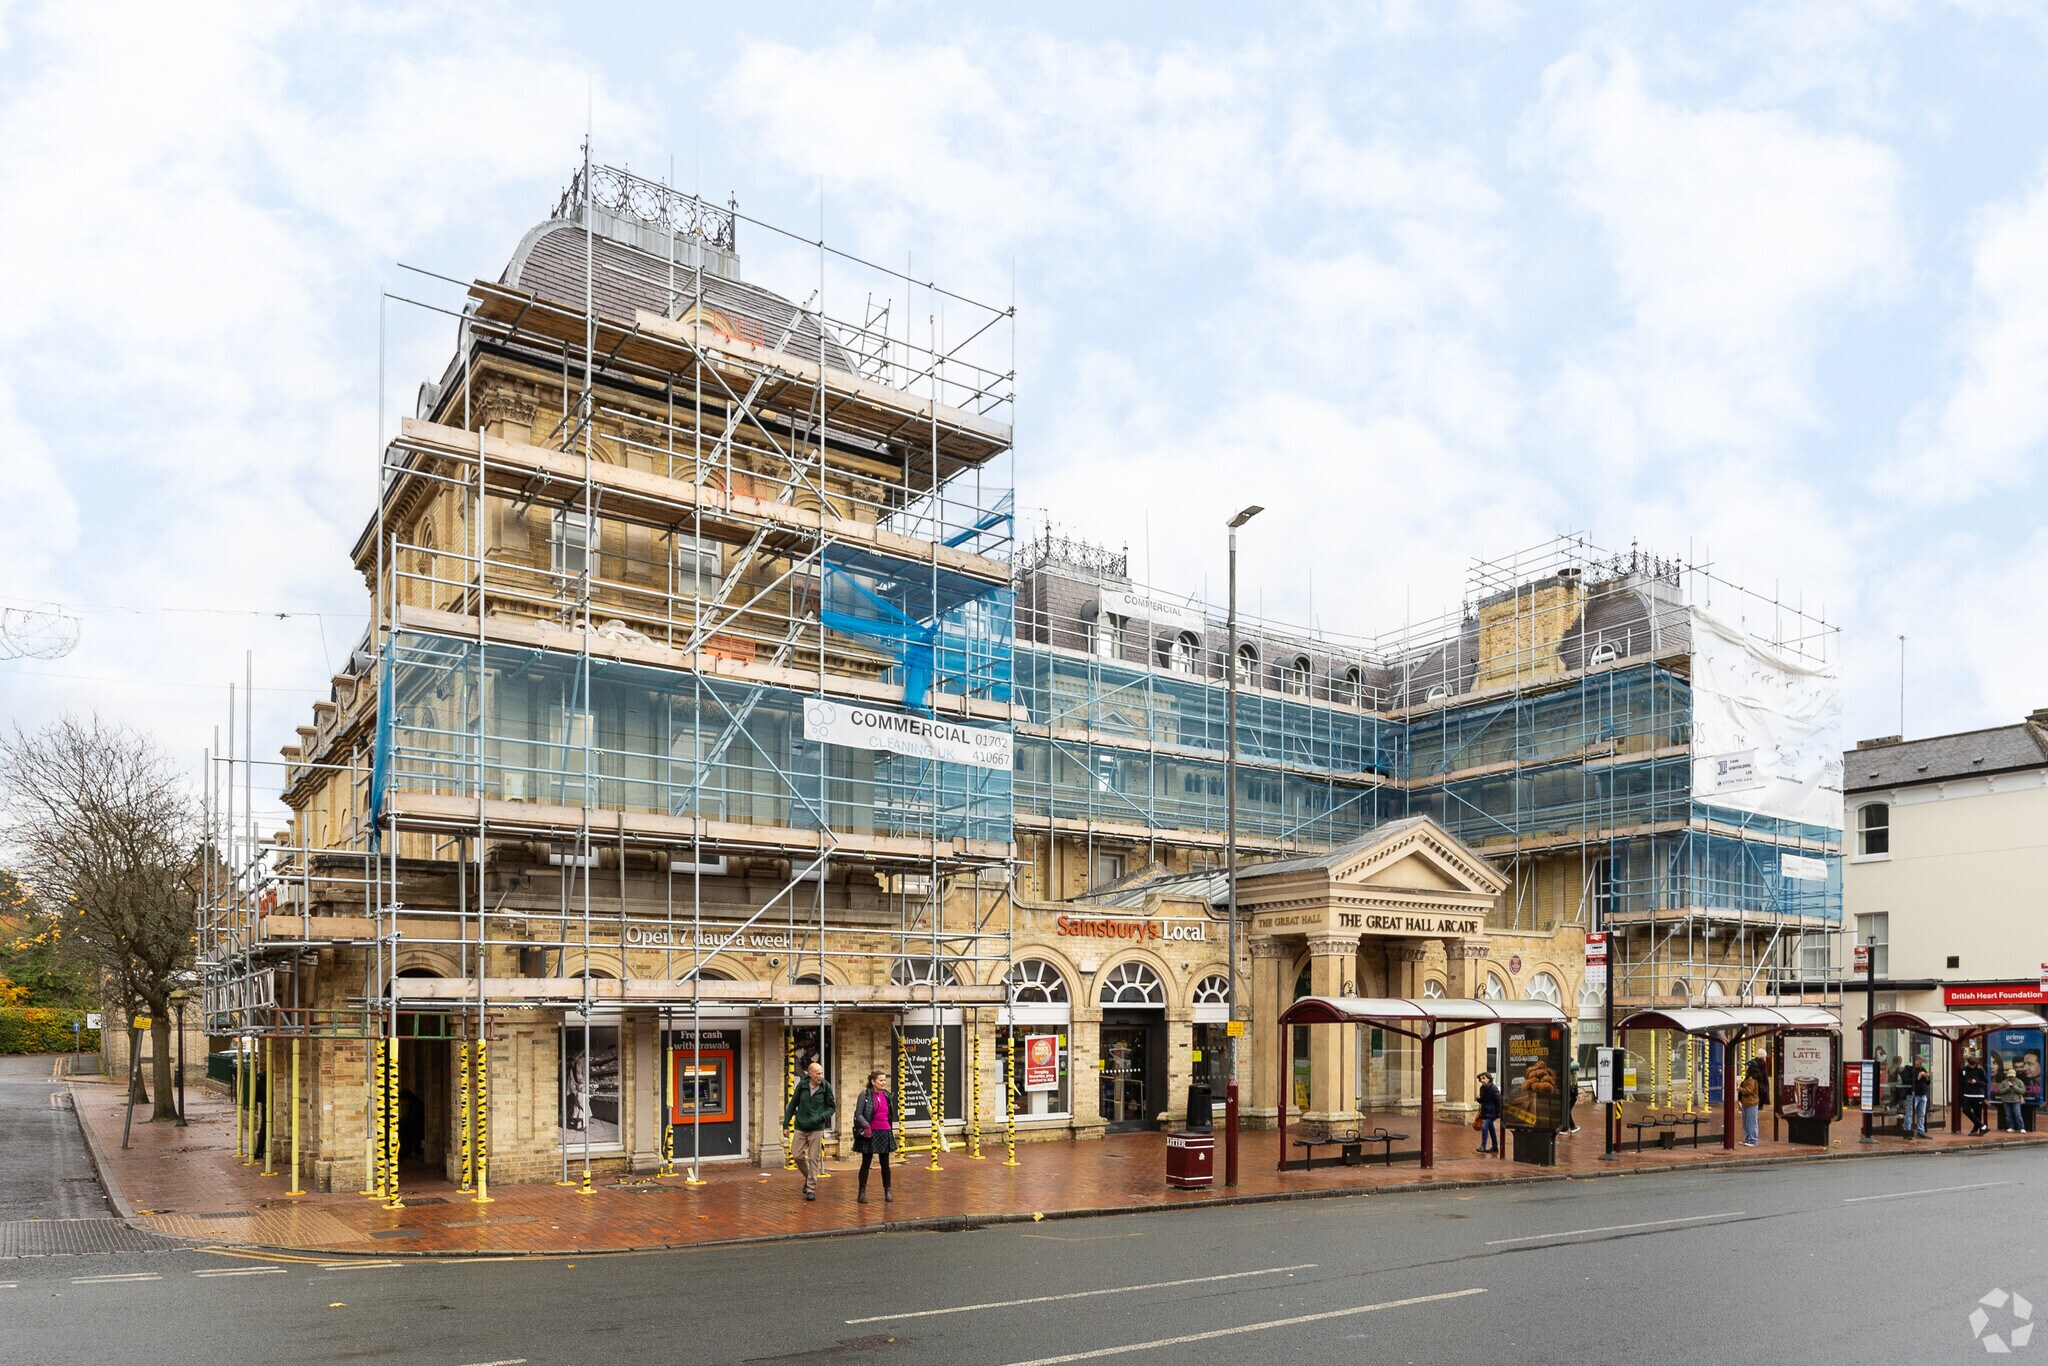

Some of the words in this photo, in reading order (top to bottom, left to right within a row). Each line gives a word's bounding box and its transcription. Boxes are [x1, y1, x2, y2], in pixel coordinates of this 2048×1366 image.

[1124, 595, 1182, 617] COMMERCIAL
[851, 710, 970, 744] COMMERCIAL
[975, 733, 1008, 748] 01702
[869, 736, 933, 758] CLEANING
[938, 746, 955, 760] UK
[973, 750, 1010, 765] 410667
[1057, 915, 1158, 943] Sainsbury's
[1162, 920, 1206, 942] Local
[1258, 919, 1273, 928] THE
[1275, 917, 1299, 927] GREAT
[1301, 914, 1322, 924] HALL
[1339, 913, 1362, 927] THE
[1366, 915, 1403, 930] GREAT
[1405, 917, 1434, 931] HALL
[1437, 919, 1478, 933] ARCADE
[679, 929, 689, 944] 7
[736, 935, 745, 946] a
[750, 933, 792, 948] week
[1951, 992, 1975, 1000] British
[1999, 990, 2043, 999] Foundation
[702, 1030, 722, 1039] cash
[673, 1041, 730, 1050] withrawals
[1792, 1051, 1821, 1059] LATTE
